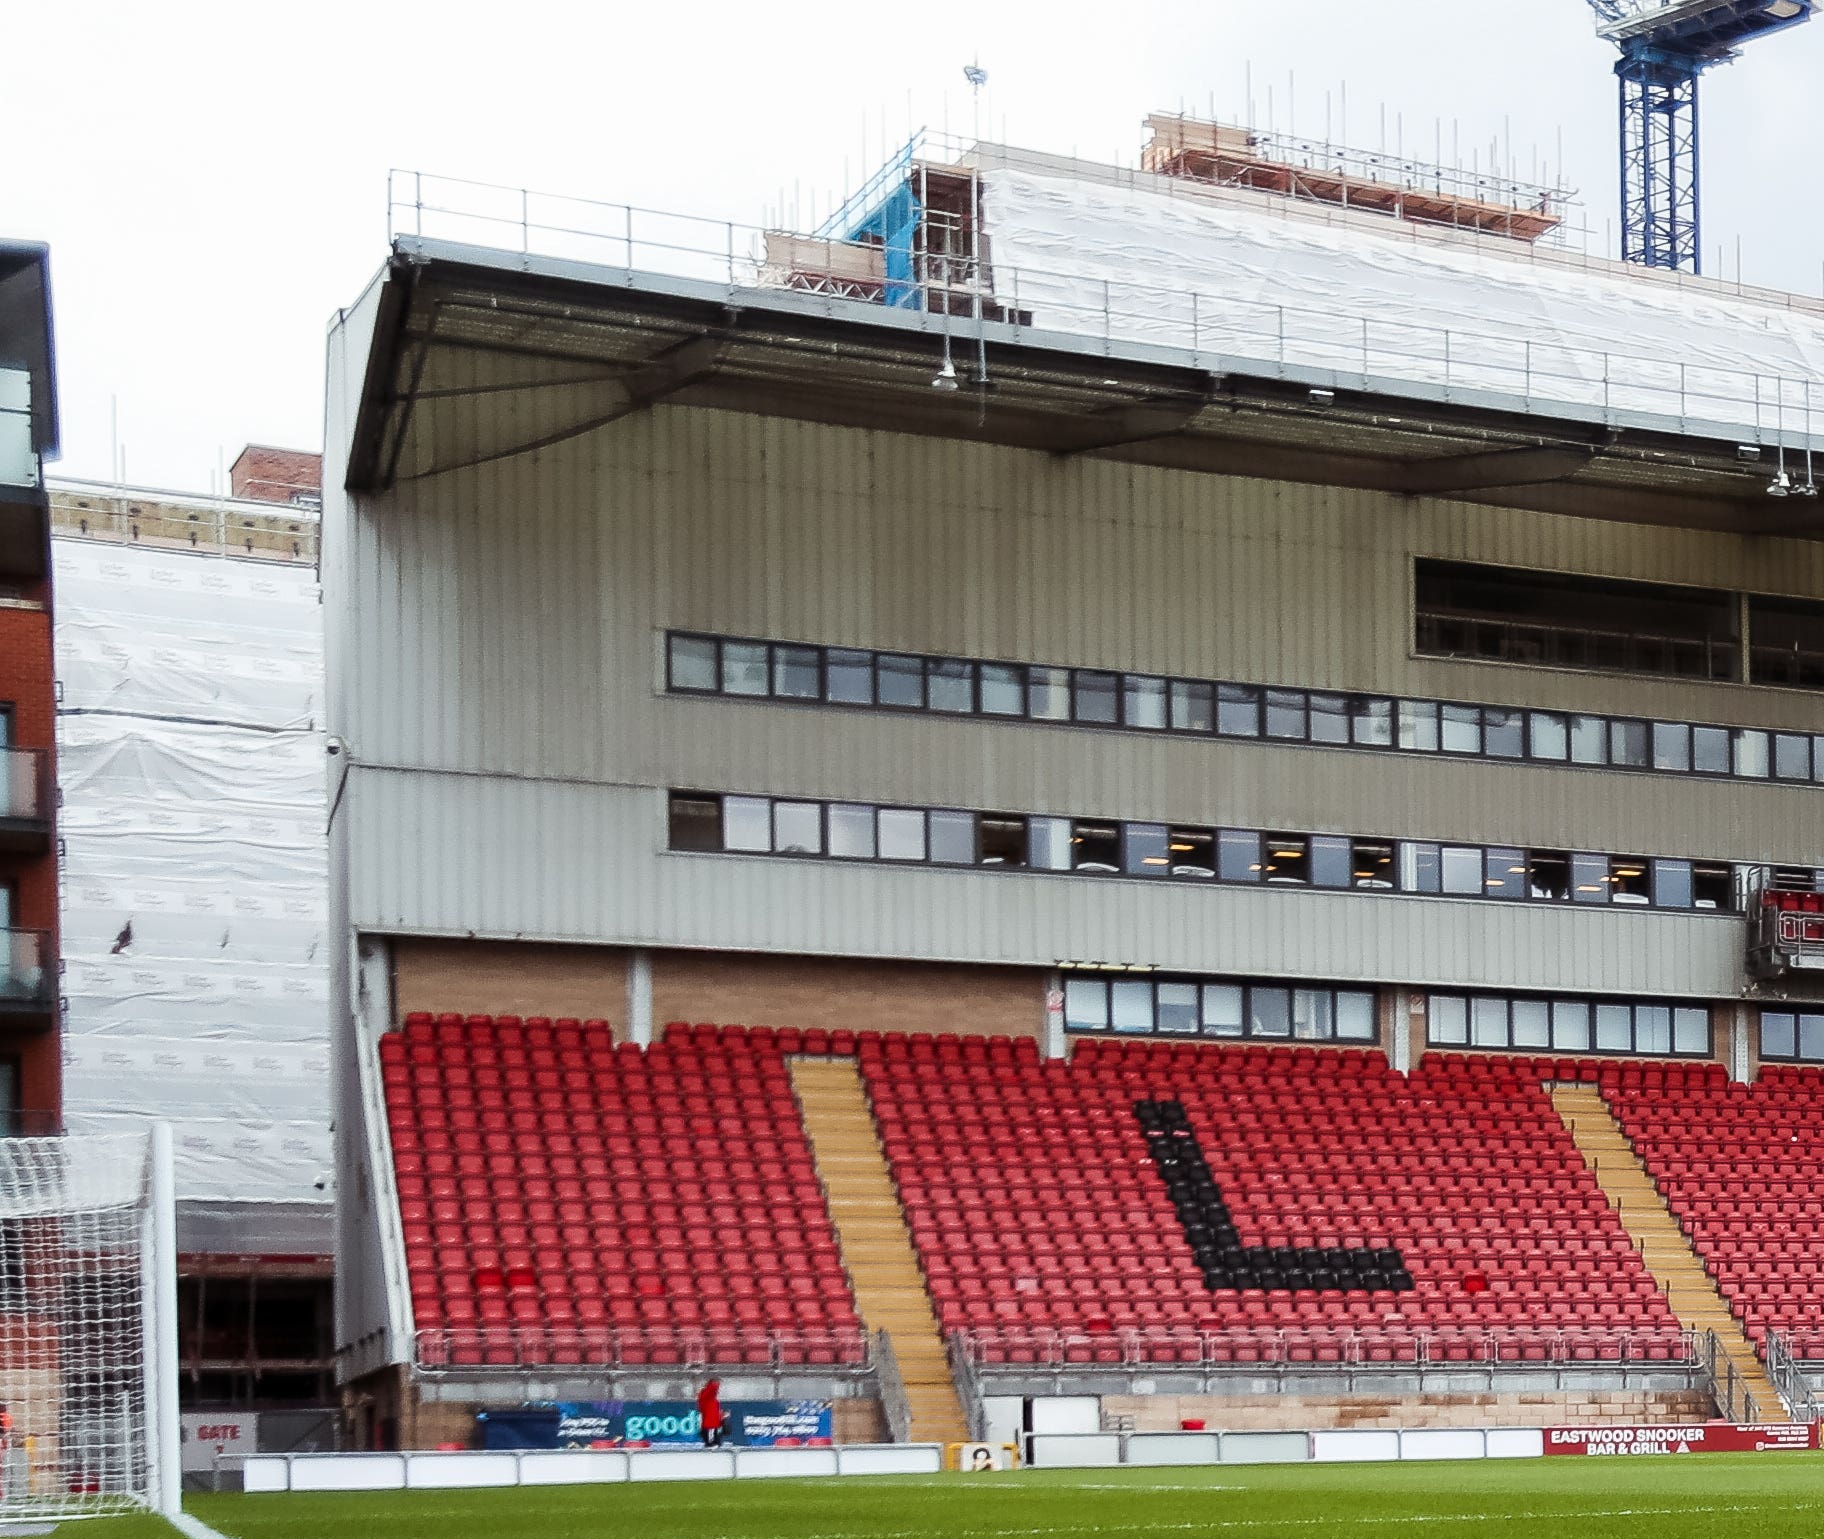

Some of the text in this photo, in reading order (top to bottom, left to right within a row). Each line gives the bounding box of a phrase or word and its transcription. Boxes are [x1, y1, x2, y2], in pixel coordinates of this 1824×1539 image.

[198, 1425, 241, 1441] GATE
[1551, 1428, 1705, 1444] EASTWOOD SNOOKER
[1587, 1442, 1671, 1456] BAR & GRILL
